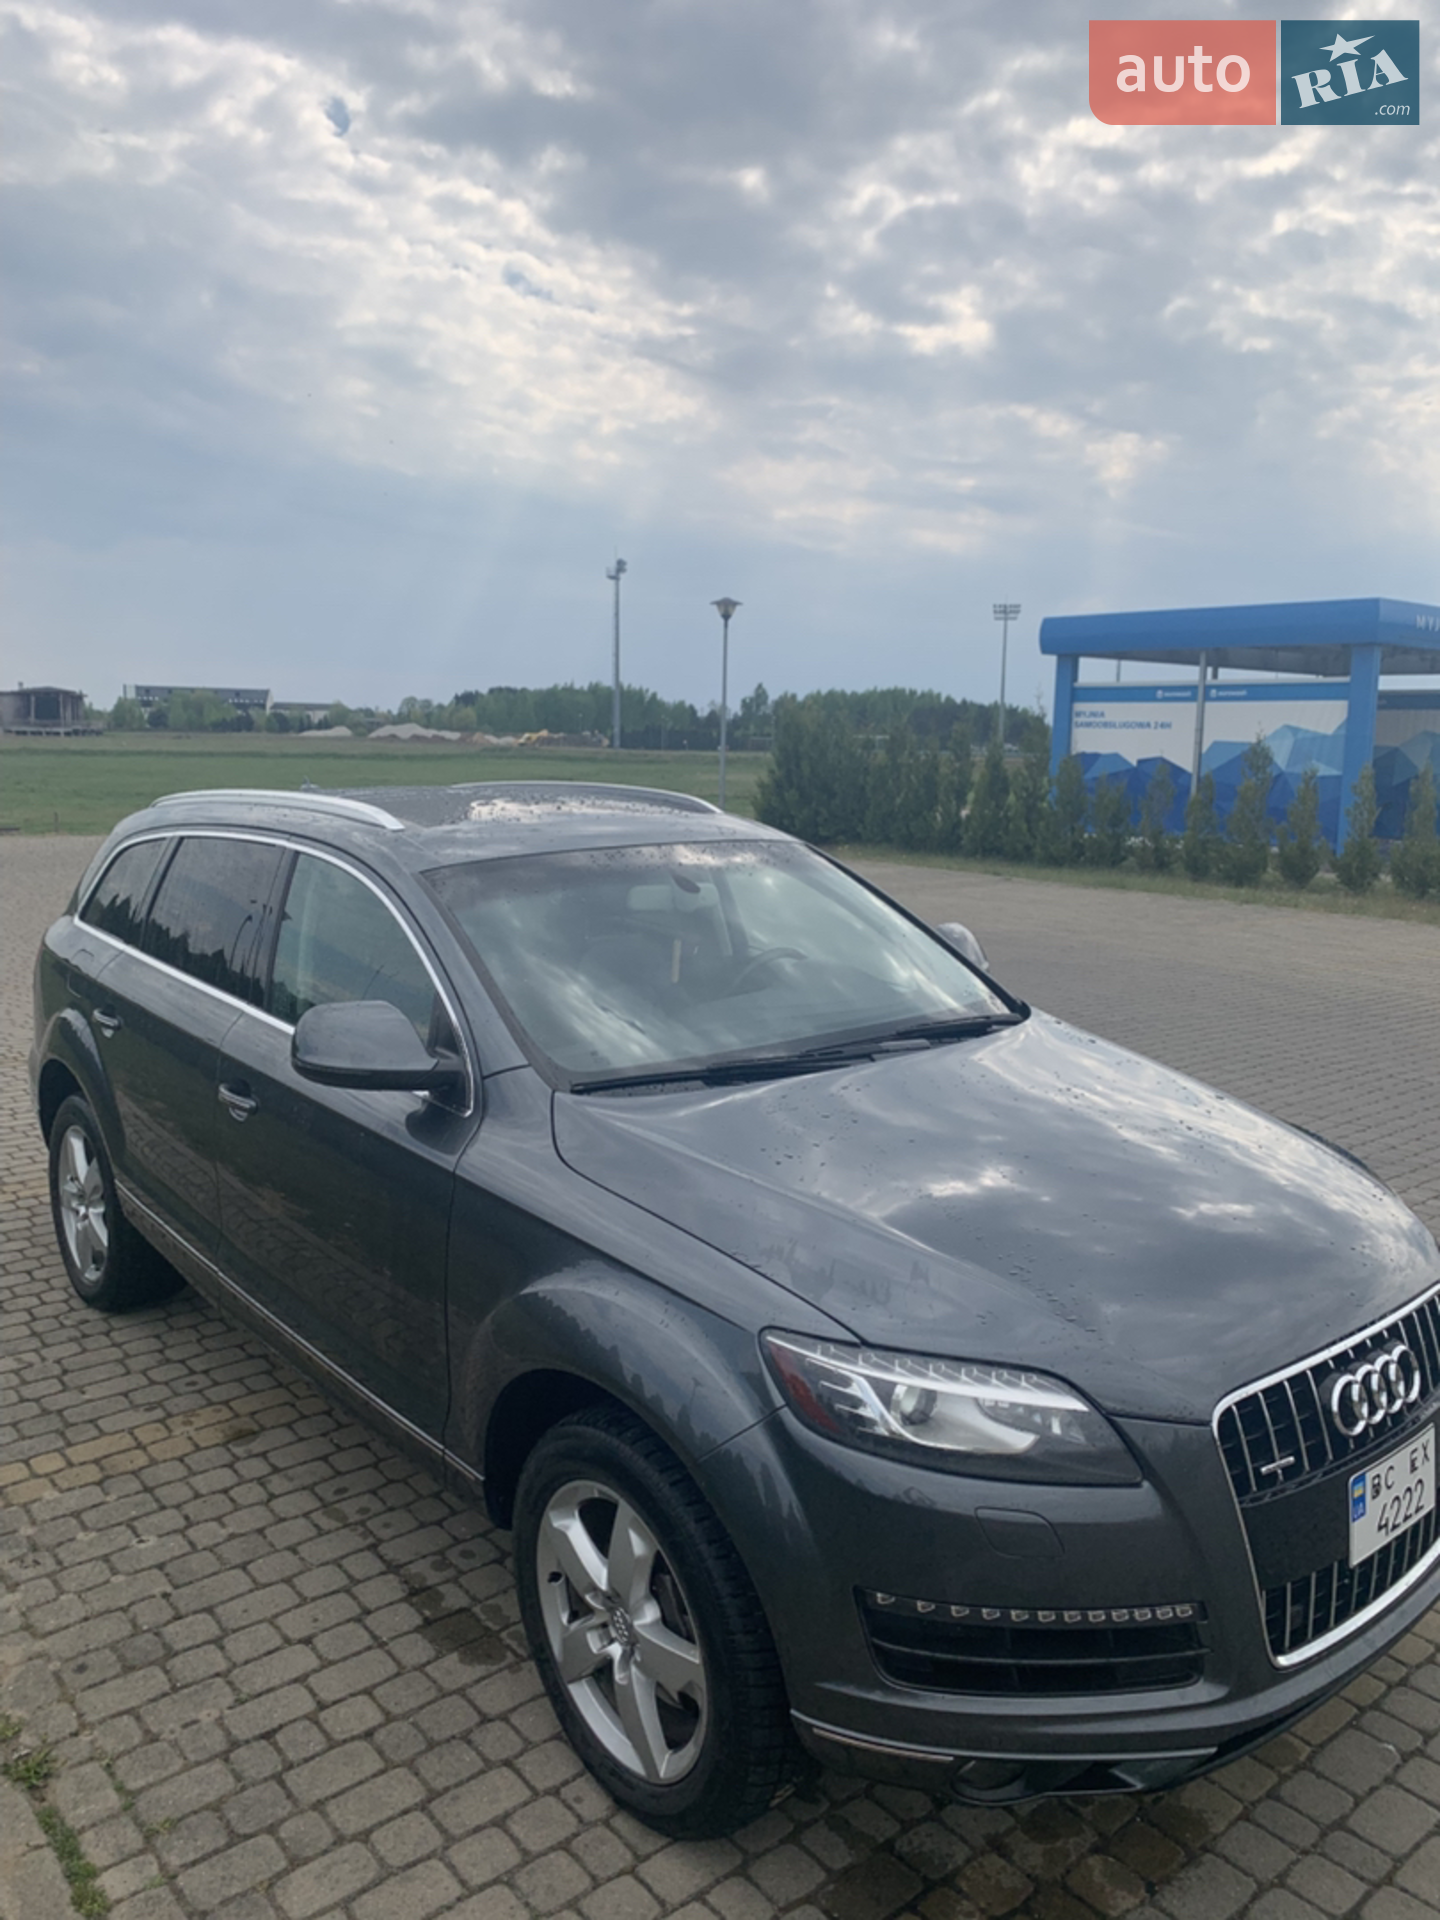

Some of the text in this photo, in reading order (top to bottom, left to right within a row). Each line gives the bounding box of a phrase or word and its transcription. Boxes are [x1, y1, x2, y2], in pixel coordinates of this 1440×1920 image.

[1371, 1440, 1430, 1500] BC EX
[1377, 1478, 1424, 1536] 4222
